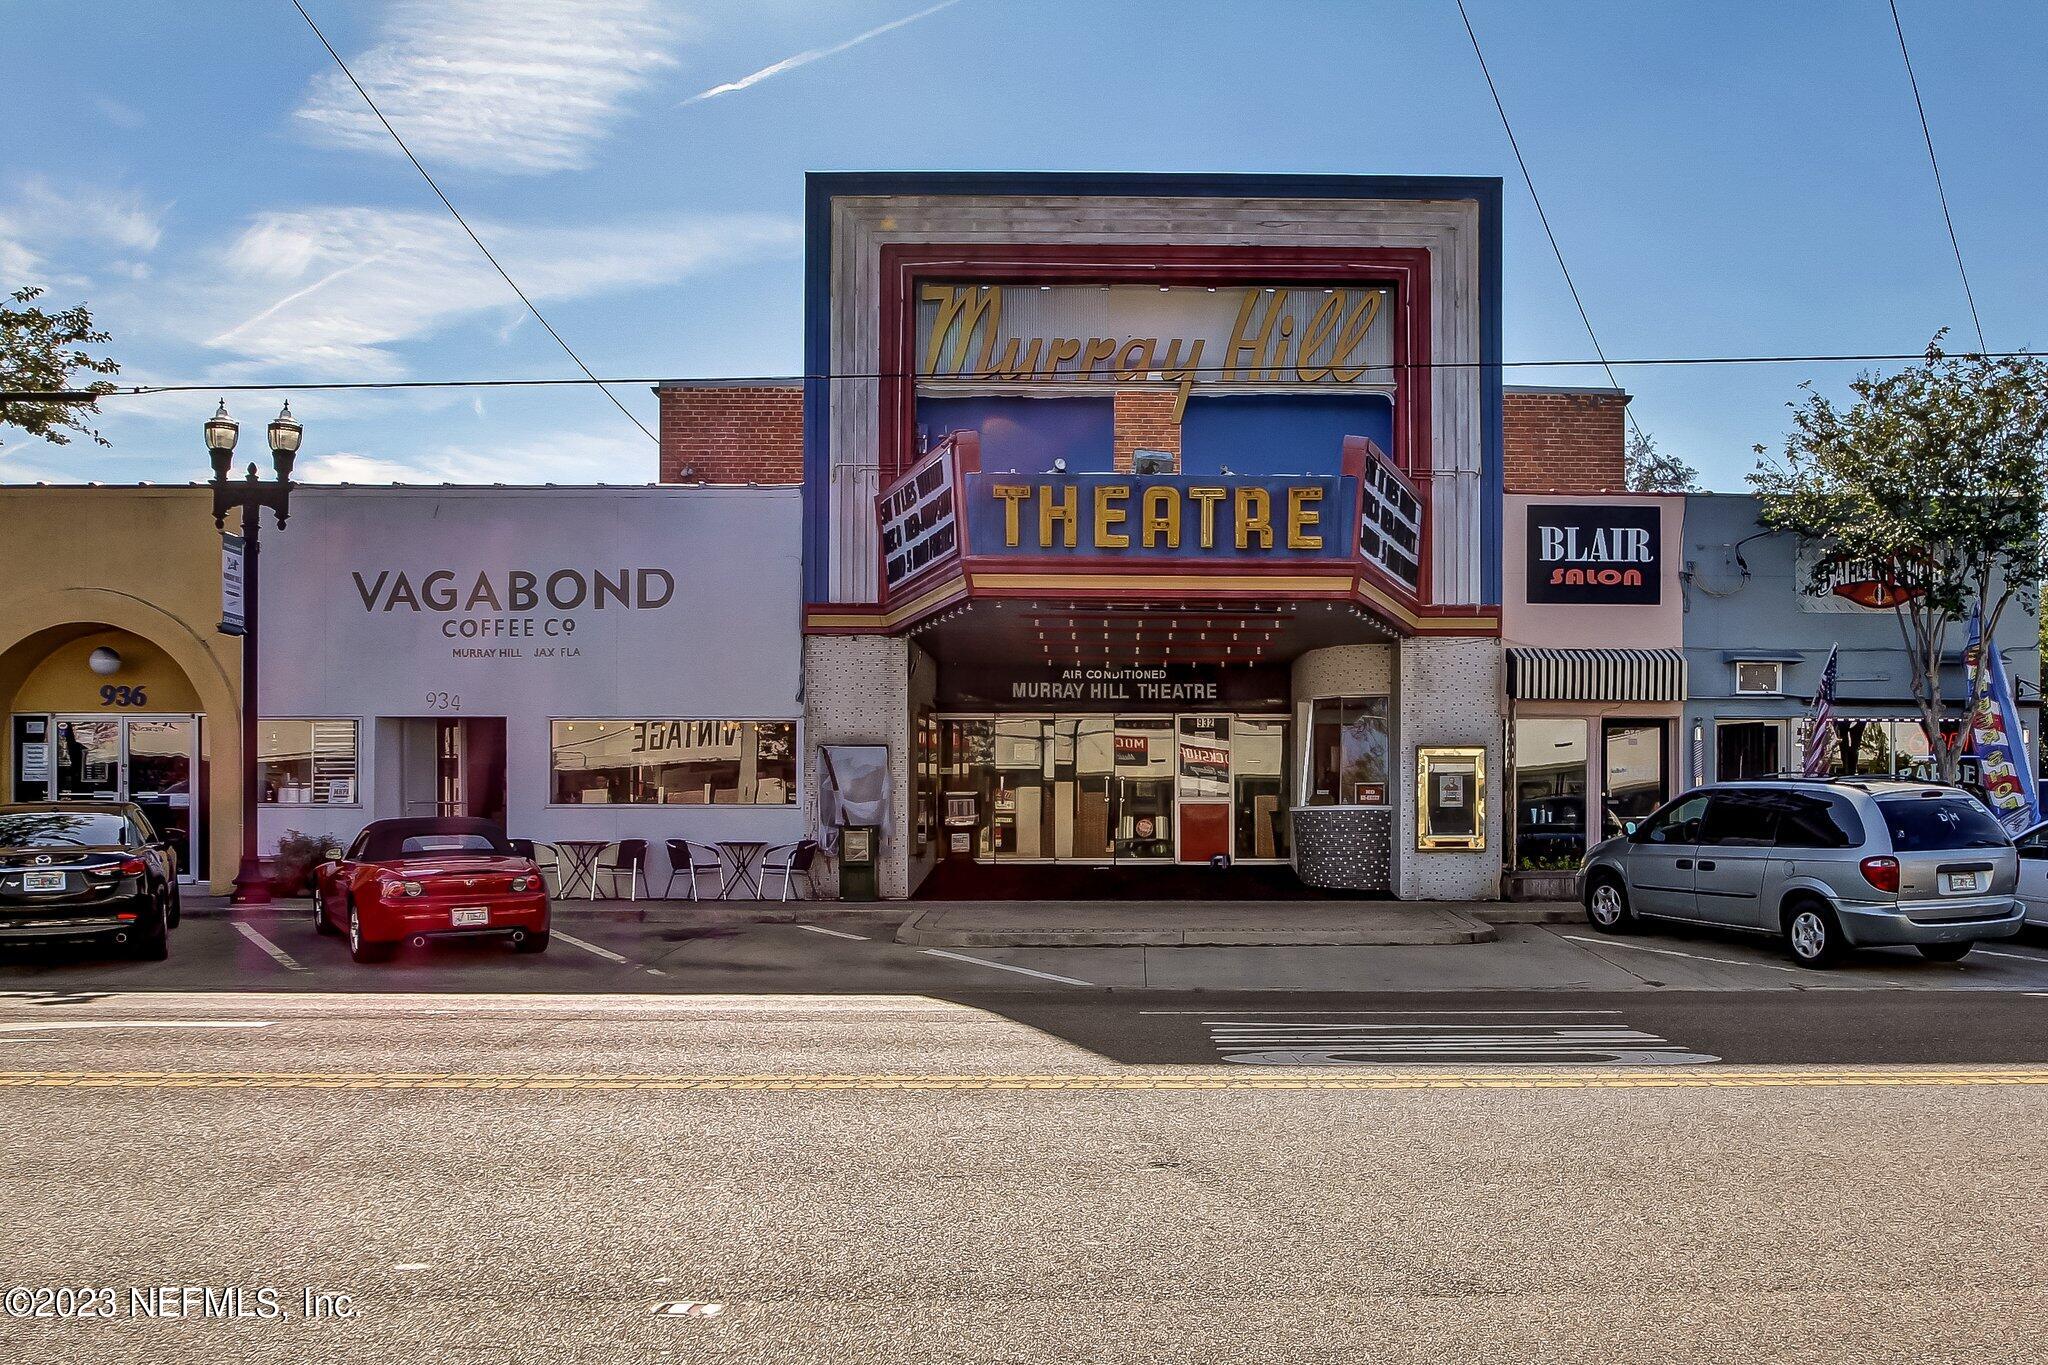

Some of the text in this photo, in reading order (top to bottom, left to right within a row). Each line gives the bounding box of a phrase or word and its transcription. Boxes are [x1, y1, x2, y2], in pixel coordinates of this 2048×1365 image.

[921, 285, 1382, 424] Murray Hill
[993, 485, 1324, 550] THEATRE
[1538, 526, 1654, 562] BLAIR
[1550, 568, 1642, 586] SALON
[351, 568, 675, 612] VAGABOND
[441, 618, 534, 638] COFFEE
[452, 648, 581, 658] MURRAY HILL JAX FLA
[1062, 670, 1167, 679] AIR CONDITIONED
[100, 684, 148, 707] 936
[1012, 682, 1218, 699] MURRAY HILL THEATRE
[425, 691, 462, 711] 934
